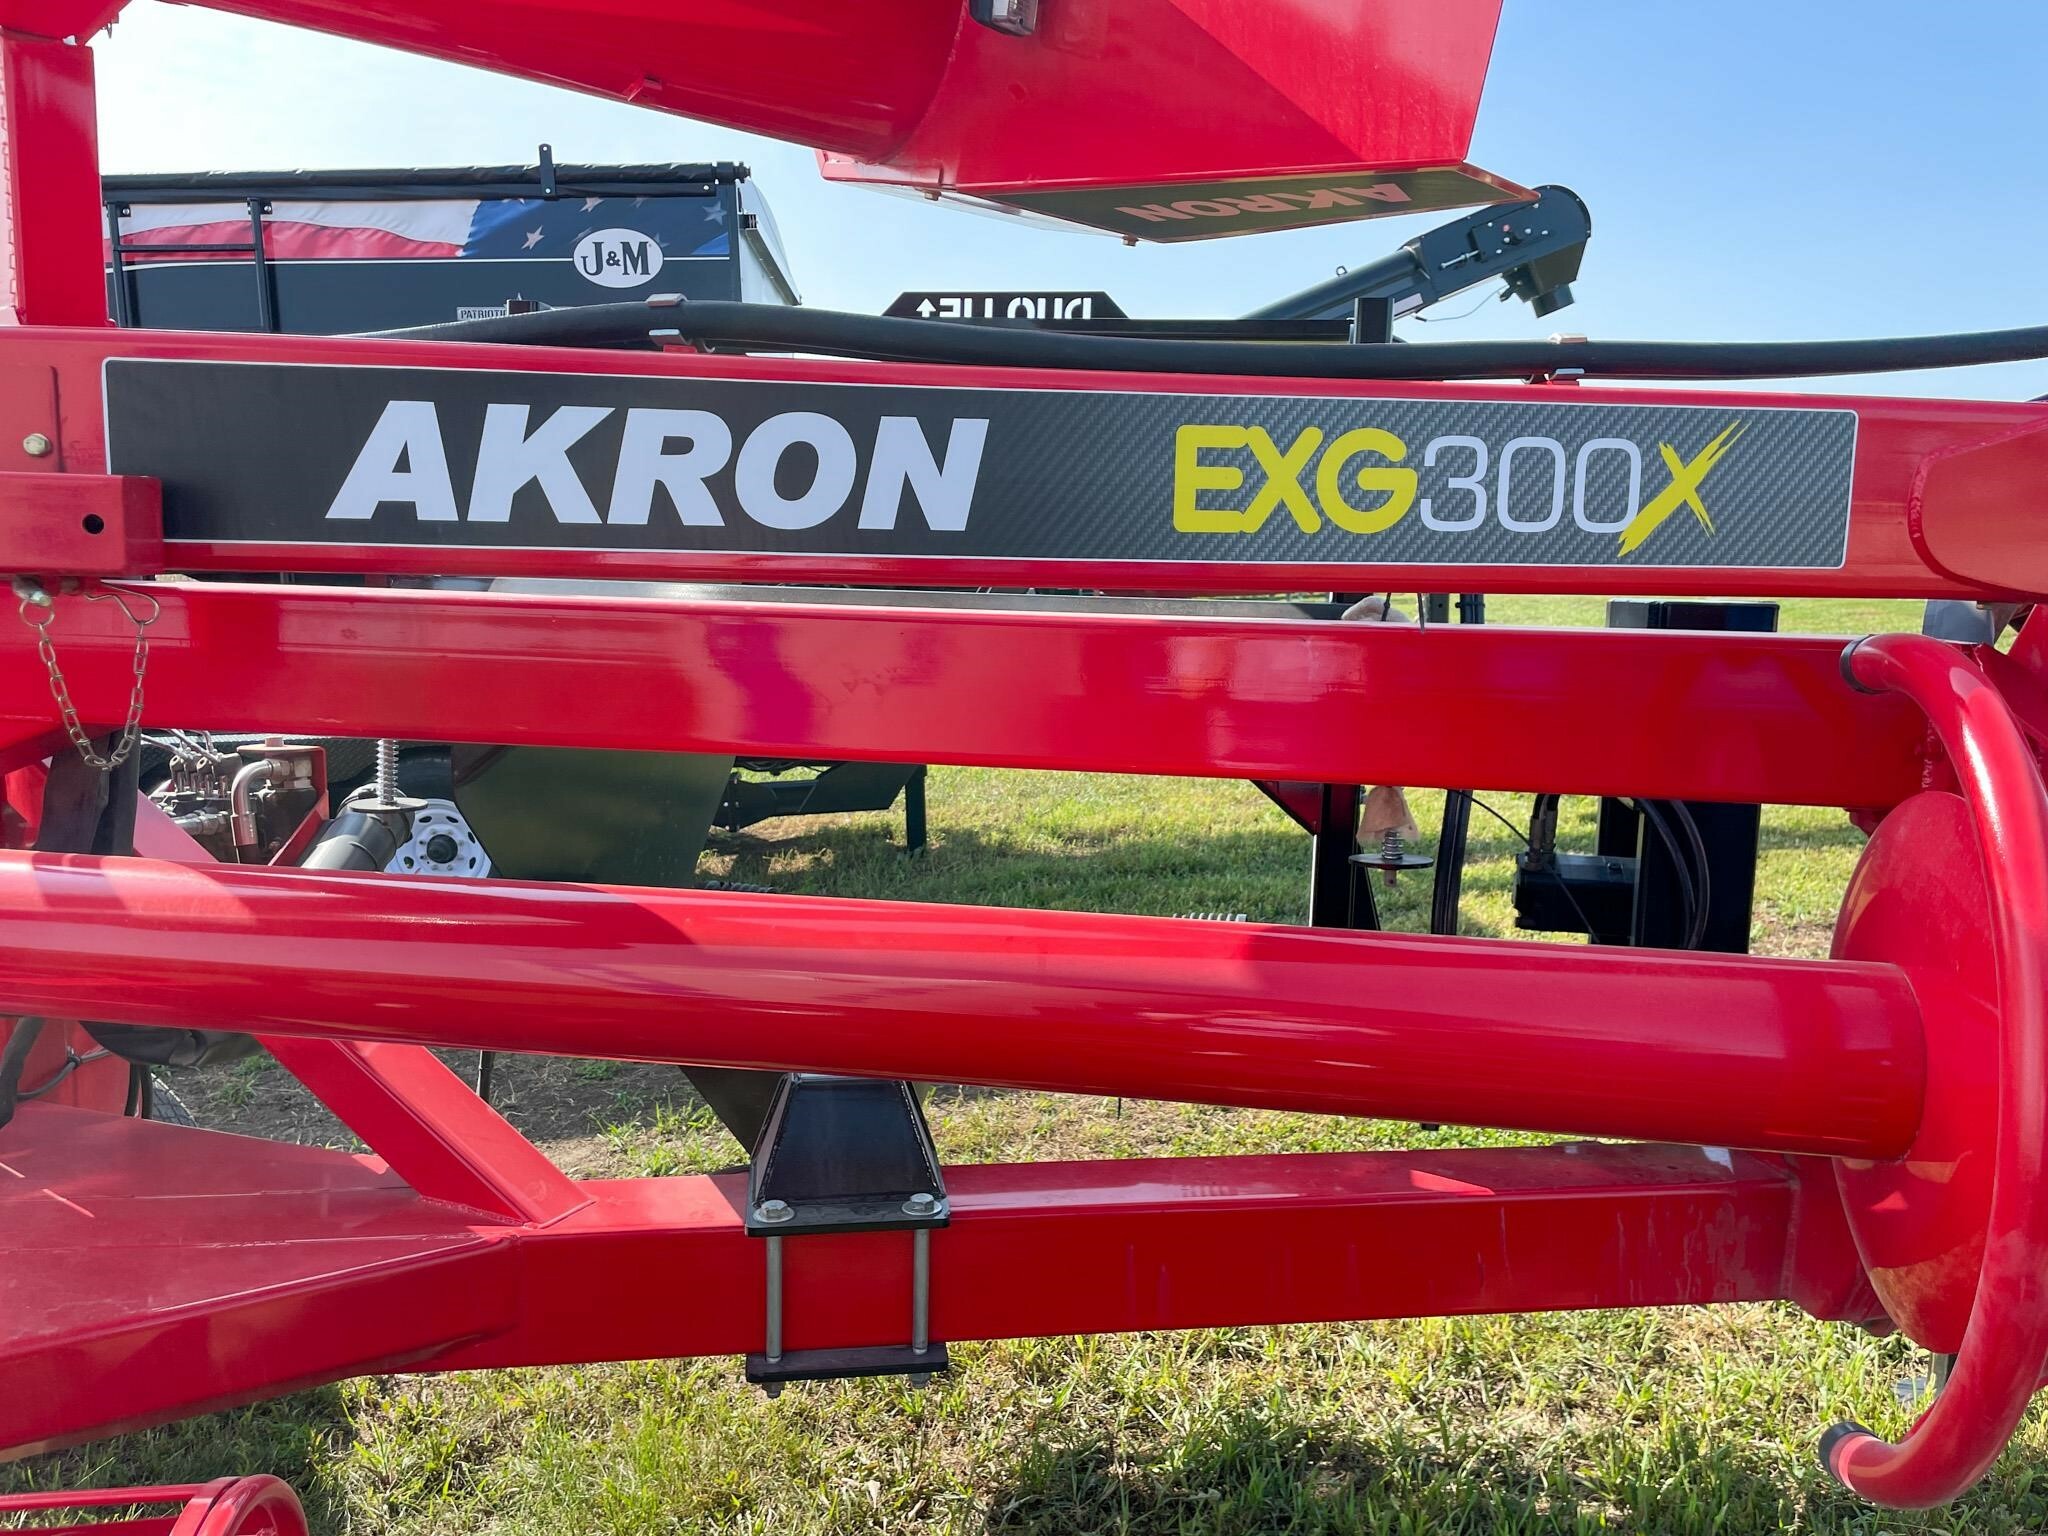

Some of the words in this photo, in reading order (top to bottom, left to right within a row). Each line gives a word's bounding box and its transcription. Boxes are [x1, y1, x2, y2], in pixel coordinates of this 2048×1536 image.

[1114, 183, 1413, 222] AKRON
[580, 241, 651, 276] J&M
[325, 399, 990, 532] AKRON
